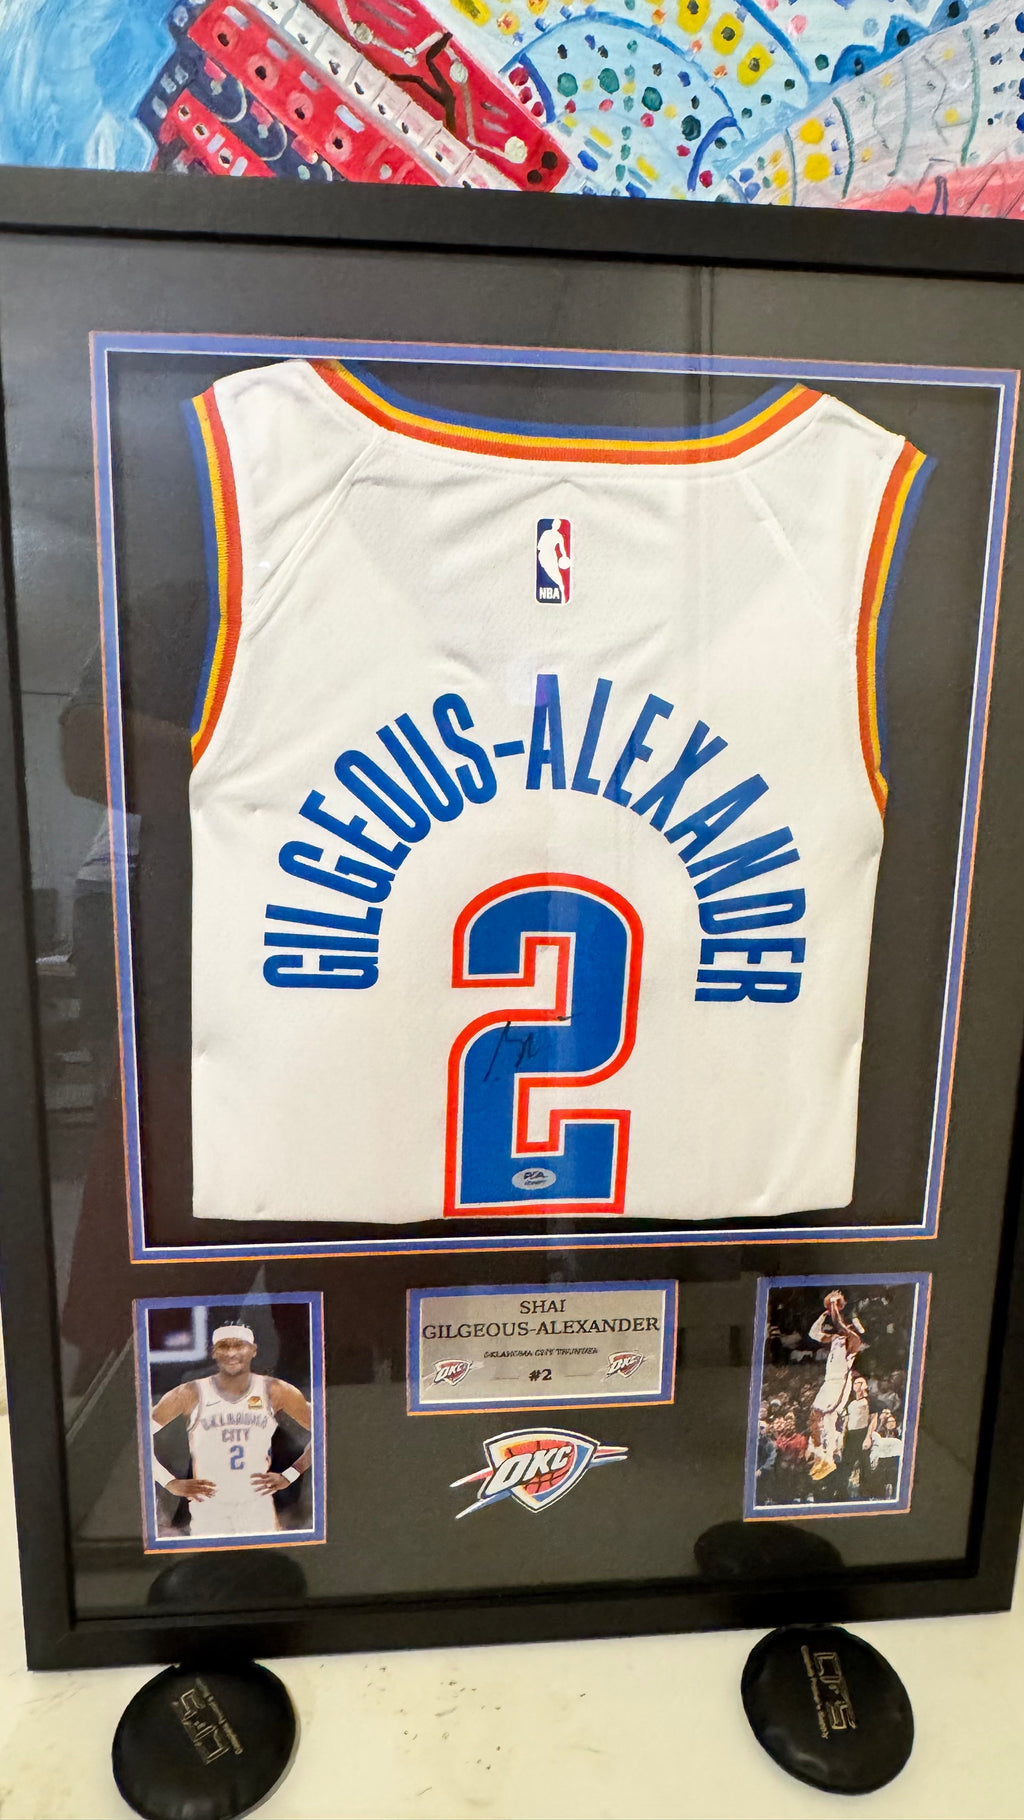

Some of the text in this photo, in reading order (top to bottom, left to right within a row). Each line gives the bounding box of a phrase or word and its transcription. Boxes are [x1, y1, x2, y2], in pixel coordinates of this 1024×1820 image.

[539, 587, 560, 600] NBA
[263, 673, 806, 1003] GILGEOUS-ALEXANDER
[443, 872, 644, 1218] 2
[519, 1299, 567, 1314] SHAI
[422, 1317, 660, 1340] GILGEOUS-ALEXANDER
[534, 1348, 555, 1357] CITY
[434, 1362, 466, 1382] OKC
[528, 1368, 553, 1382] #2
[221, 1428, 251, 1443] CITY
[229, 1445, 245, 1470] 2
[484, 1445, 573, 1496] OKC
